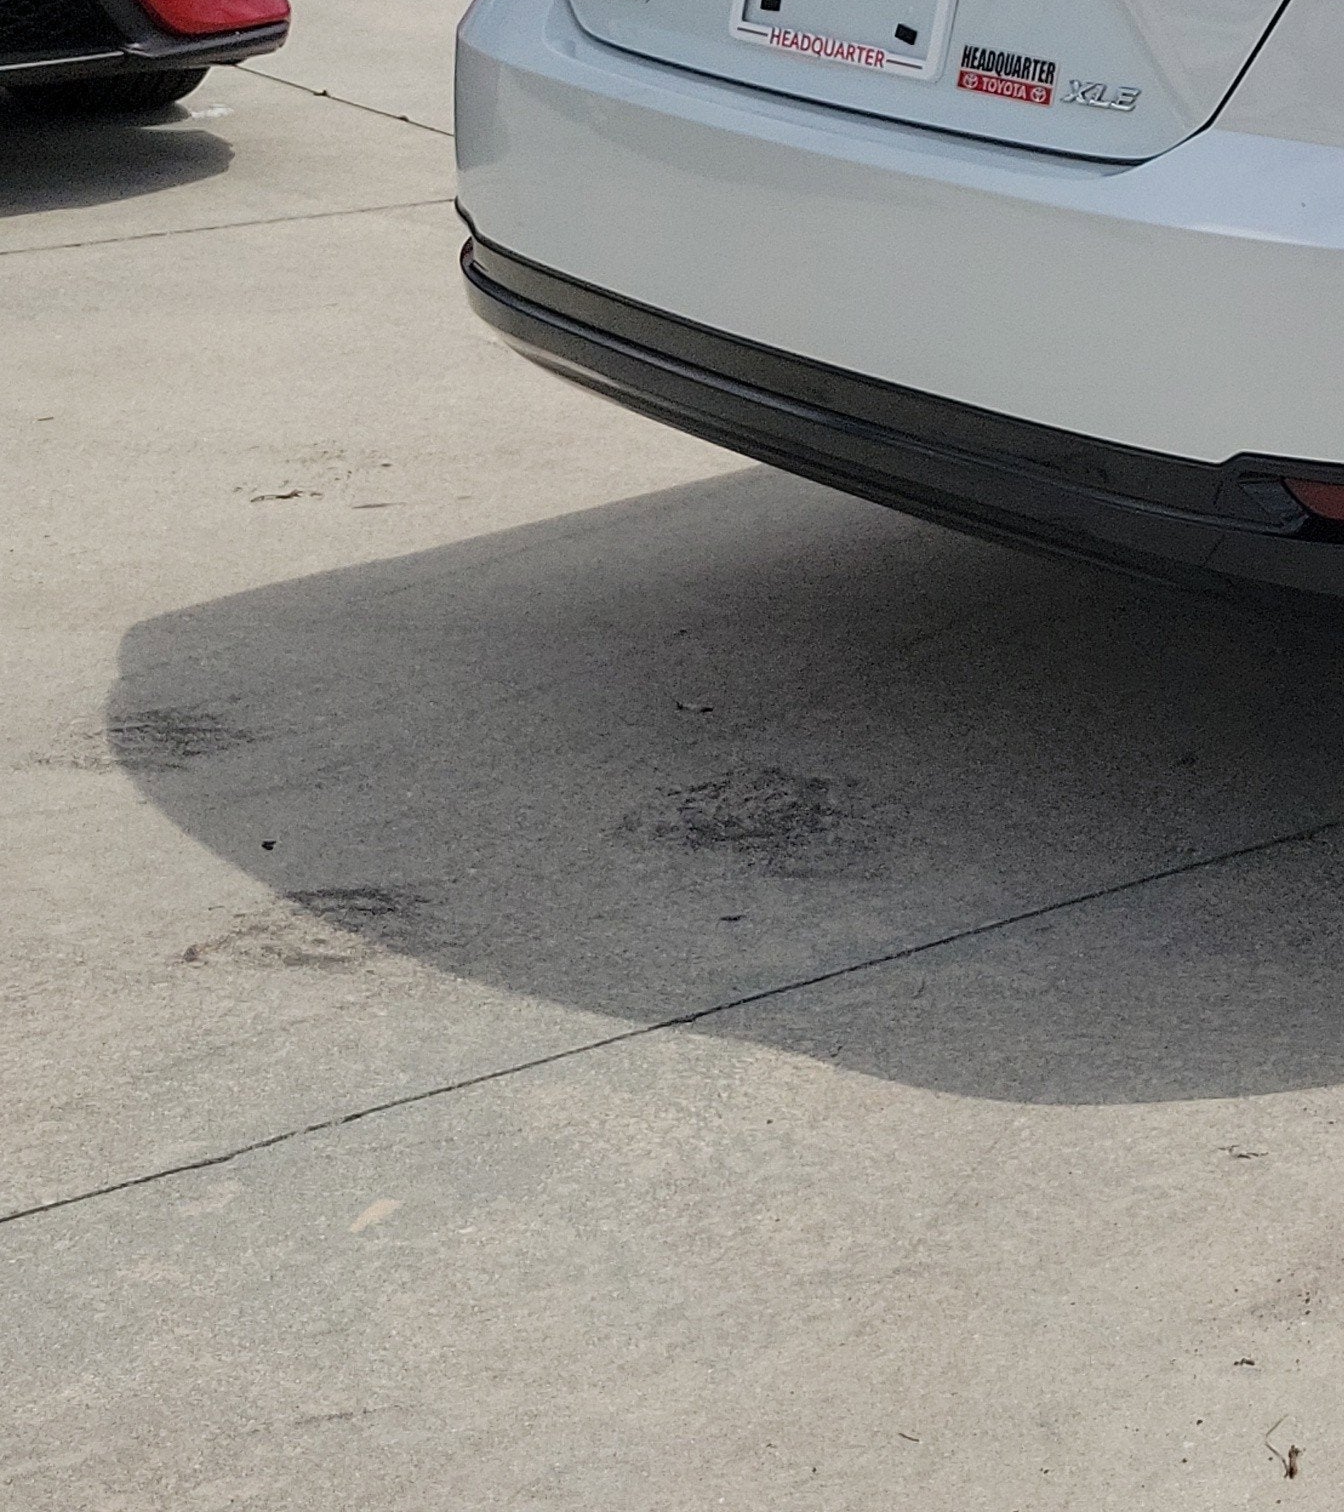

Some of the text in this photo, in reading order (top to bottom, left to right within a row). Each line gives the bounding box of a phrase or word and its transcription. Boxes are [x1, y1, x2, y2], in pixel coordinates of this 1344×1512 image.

[769, 28, 886, 69] HEADQUARTER
[961, 45, 1057, 84] HEADQUARTER
[981, 76, 1027, 100] TOYOTA
[1060, 79, 1142, 113] XLE
